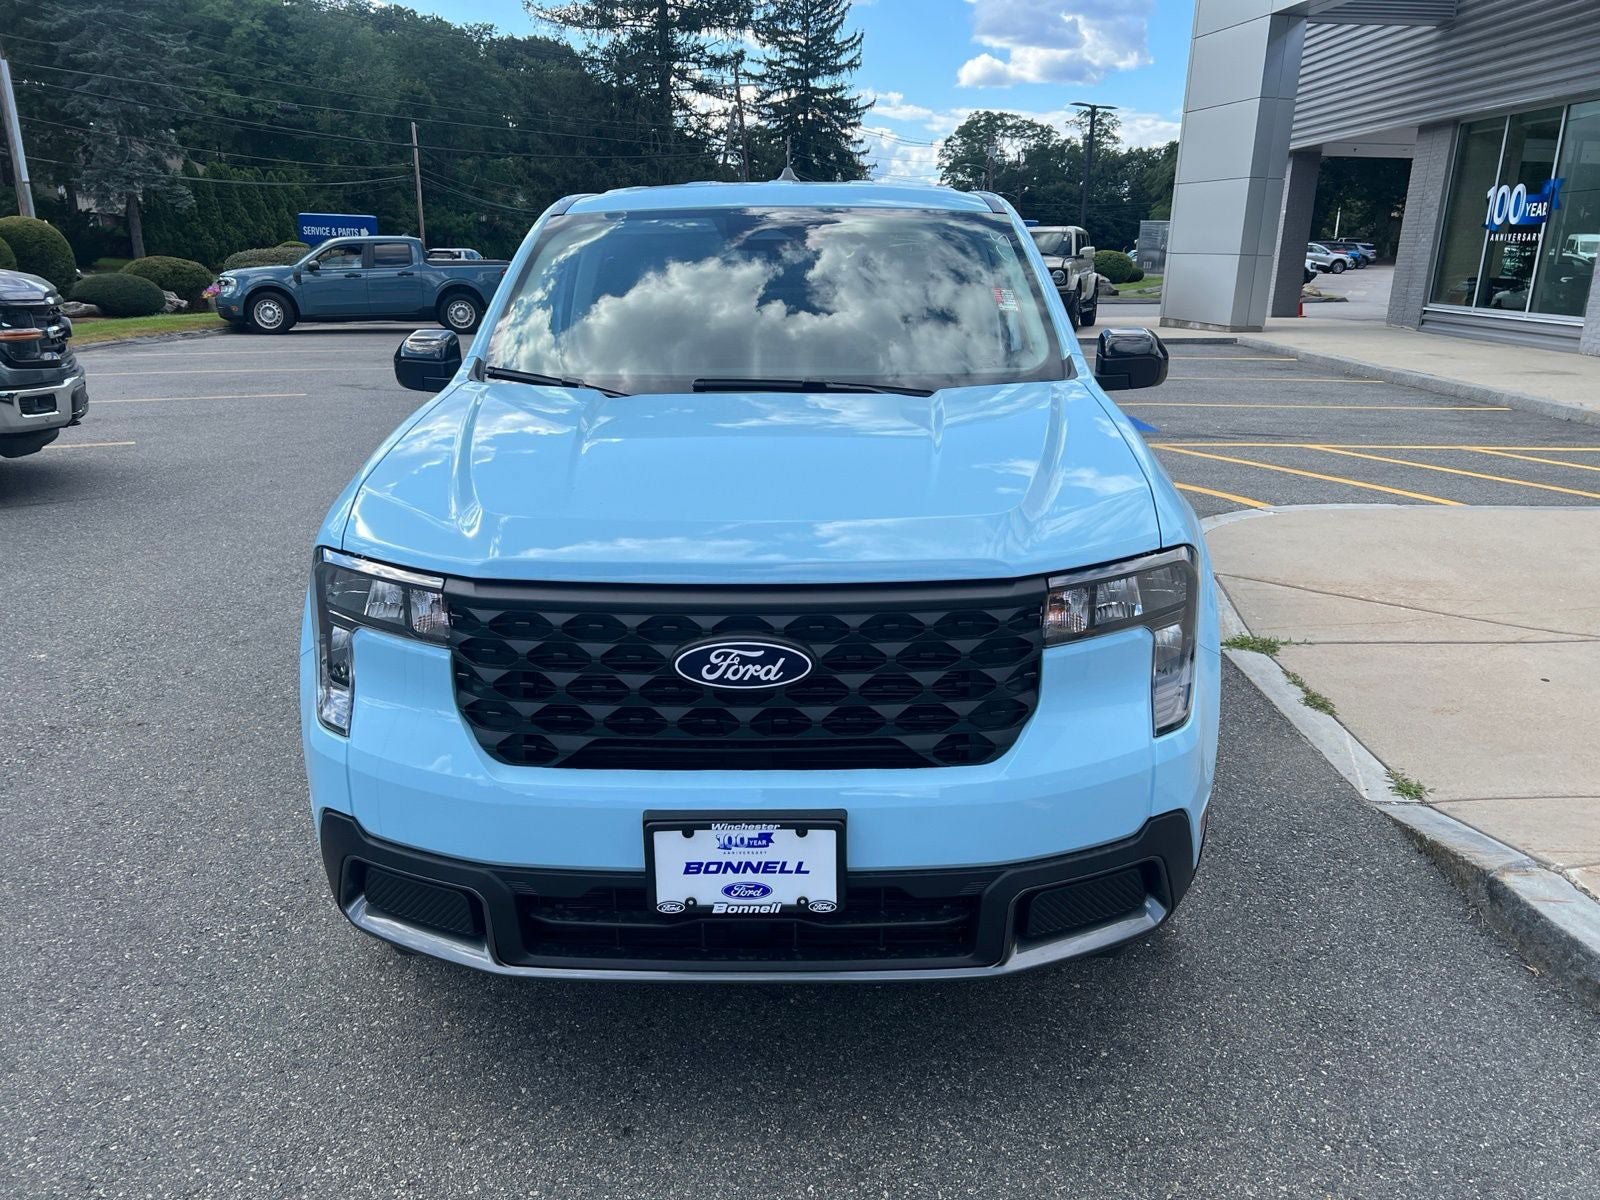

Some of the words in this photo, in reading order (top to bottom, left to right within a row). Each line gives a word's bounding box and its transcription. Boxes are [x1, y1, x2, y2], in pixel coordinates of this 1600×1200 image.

[1486, 183, 1527, 225] 100
[302, 226, 331, 236] SERVICE
[331, 227, 338, 237] &
[337, 227, 360, 237] PARTS
[1490, 232, 1543, 242] ANNIVERSARY
[701, 649, 786, 681] Ford
[711, 823, 781, 831] Winchester
[716, 832, 750, 849] 100
[683, 861, 811, 875] BONNELL
[730, 883, 763, 898] Ford
[712, 902, 782, 914] Bonnell
